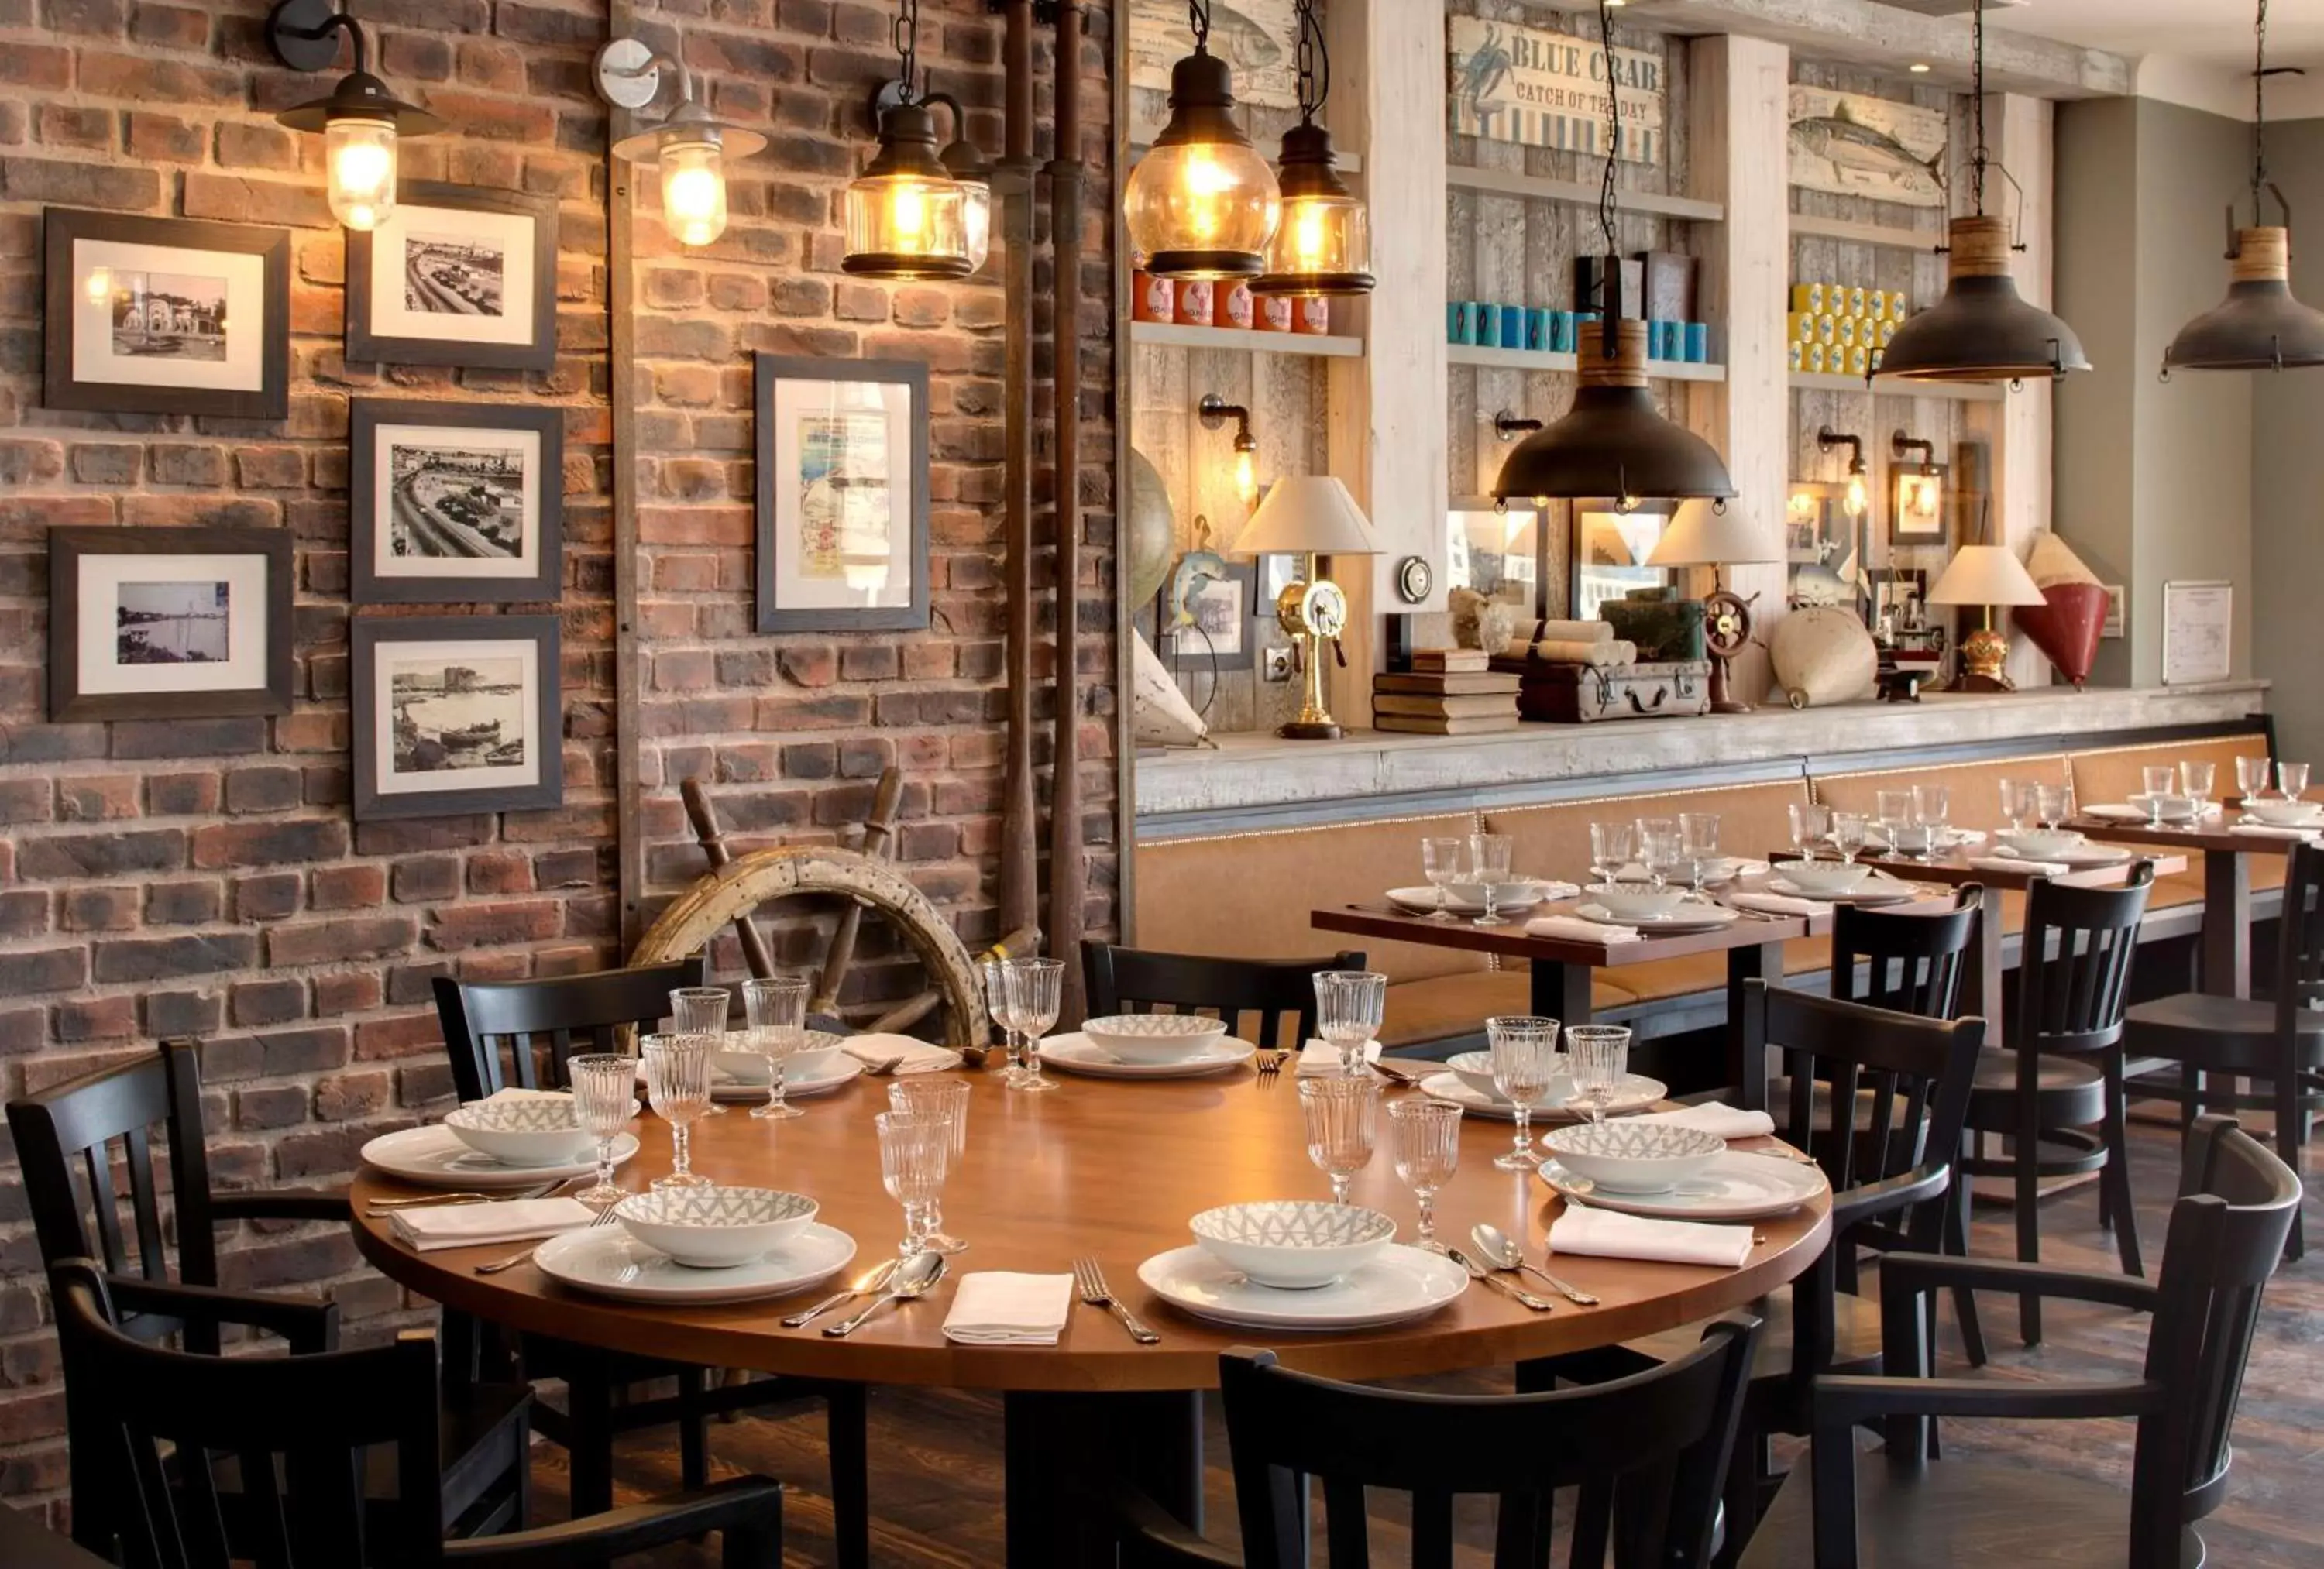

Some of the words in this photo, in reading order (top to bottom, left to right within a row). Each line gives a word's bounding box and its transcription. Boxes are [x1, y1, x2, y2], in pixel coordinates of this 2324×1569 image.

[1511, 35, 1580, 77] BLUE
[1590, 50, 1658, 91] CRAB
[1516, 81, 1564, 106] CATCH
[1569, 91, 1585, 110] OF
[1620, 101, 1647, 119] DAY
